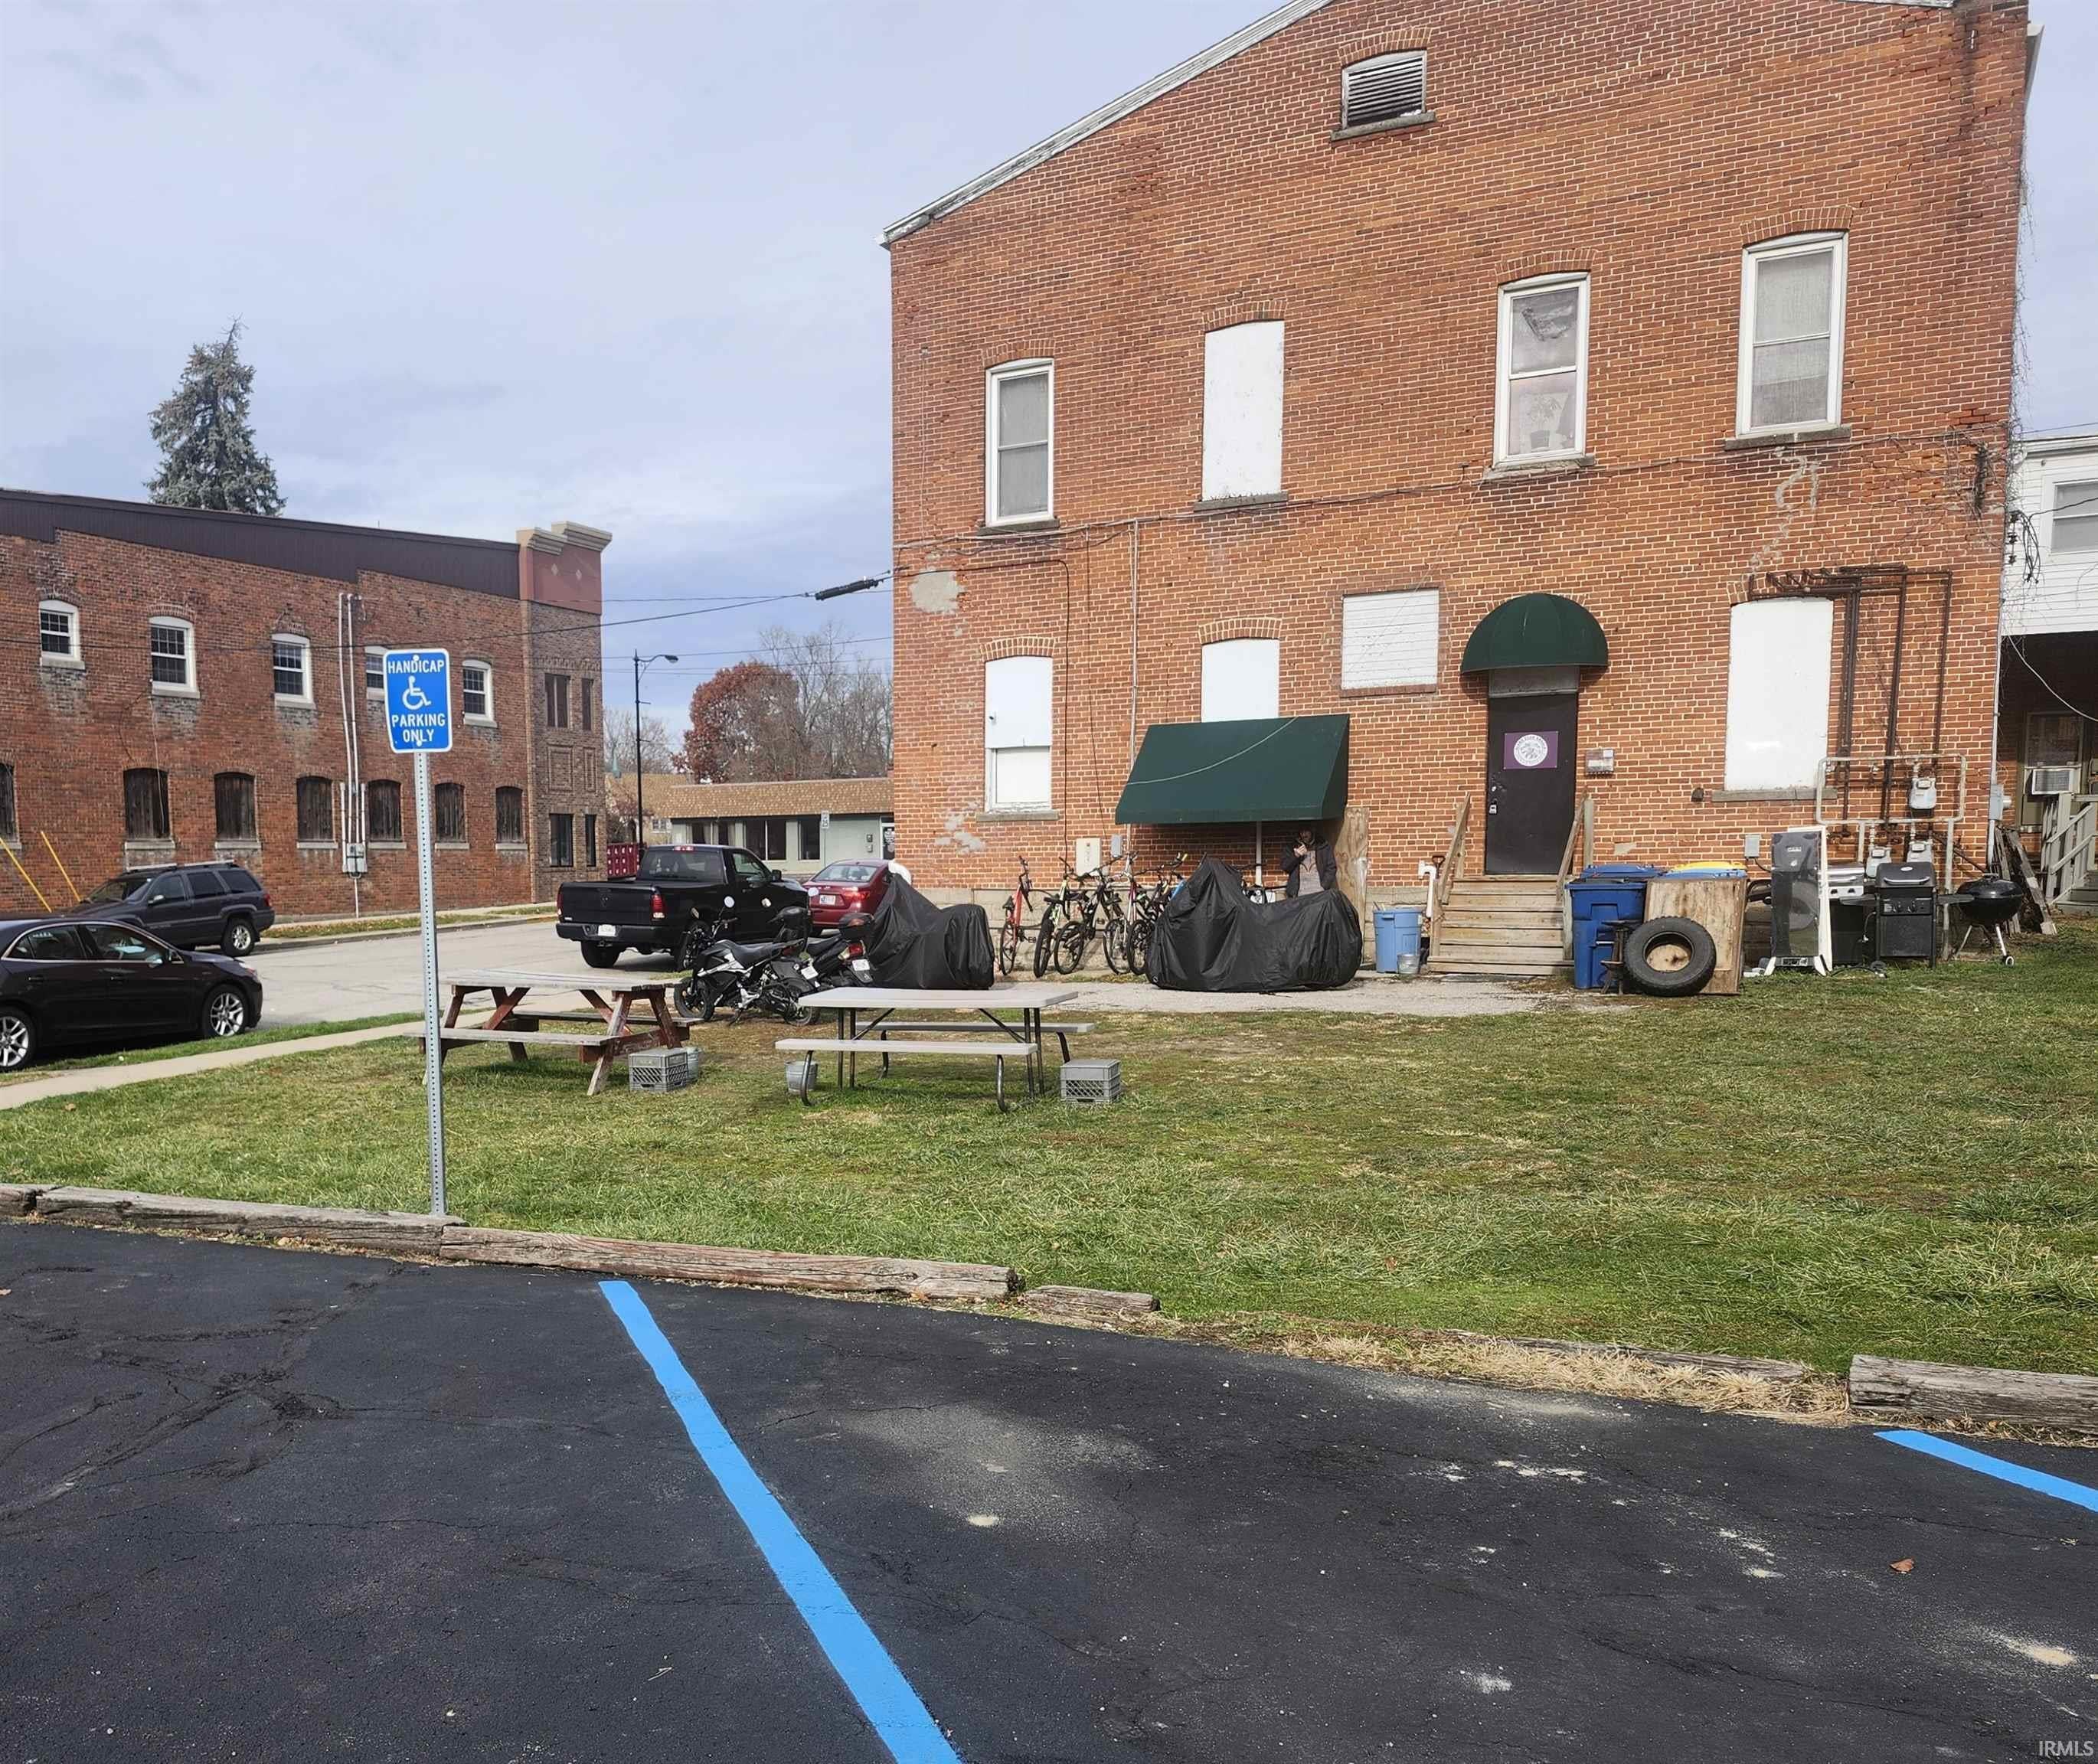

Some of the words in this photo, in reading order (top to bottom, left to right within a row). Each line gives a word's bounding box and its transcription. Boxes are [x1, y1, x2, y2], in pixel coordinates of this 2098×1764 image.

[388, 659, 444, 674] HANDICAP
[391, 713, 446, 727] PARKING
[403, 729, 434, 743] ONLY
